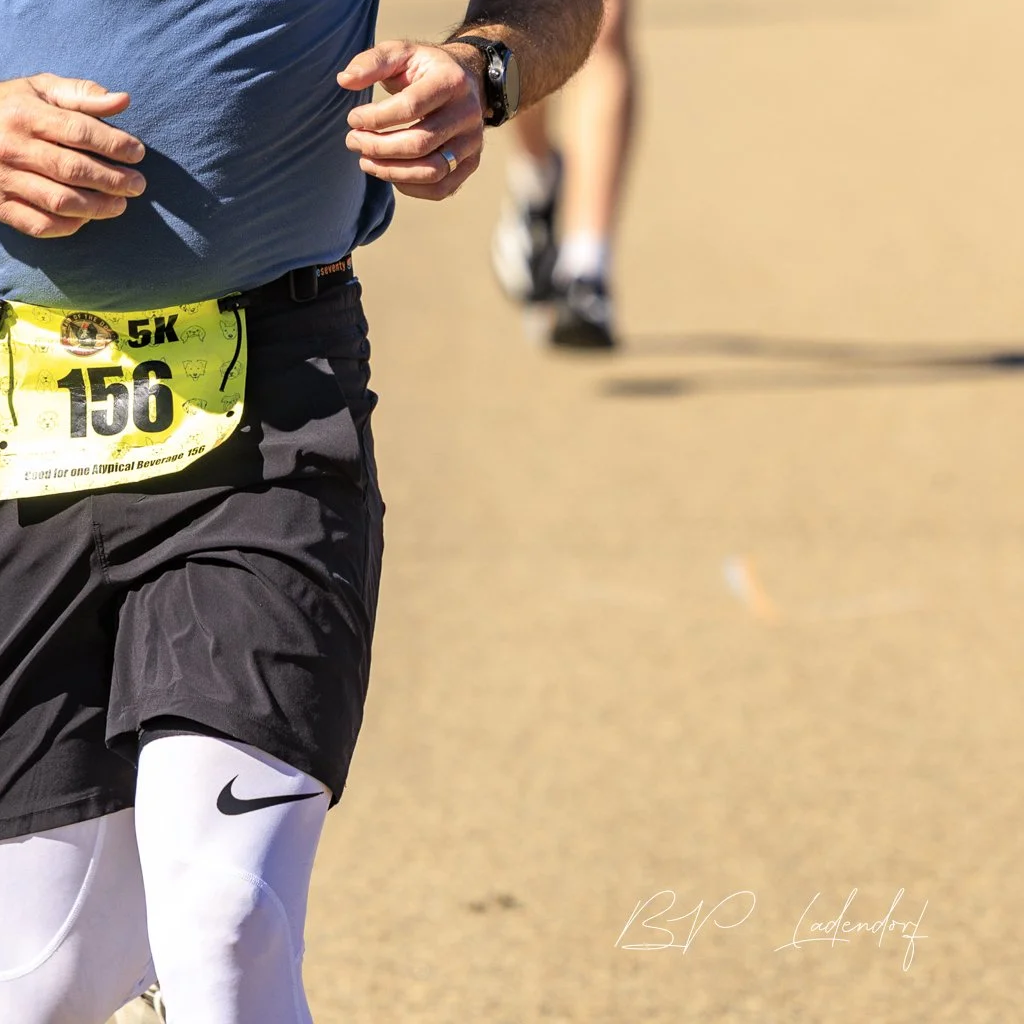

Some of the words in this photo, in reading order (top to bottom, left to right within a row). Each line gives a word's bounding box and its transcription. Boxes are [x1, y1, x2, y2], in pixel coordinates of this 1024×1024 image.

[128, 314, 179, 348] 5K
[57, 360, 174, 437] 156
[53, 468, 69, 479] for
[70, 466, 90, 477] one
[91, 462, 135, 475] Atypical
[136, 452, 184, 470] Beverage
[187, 445, 206, 457] 156
